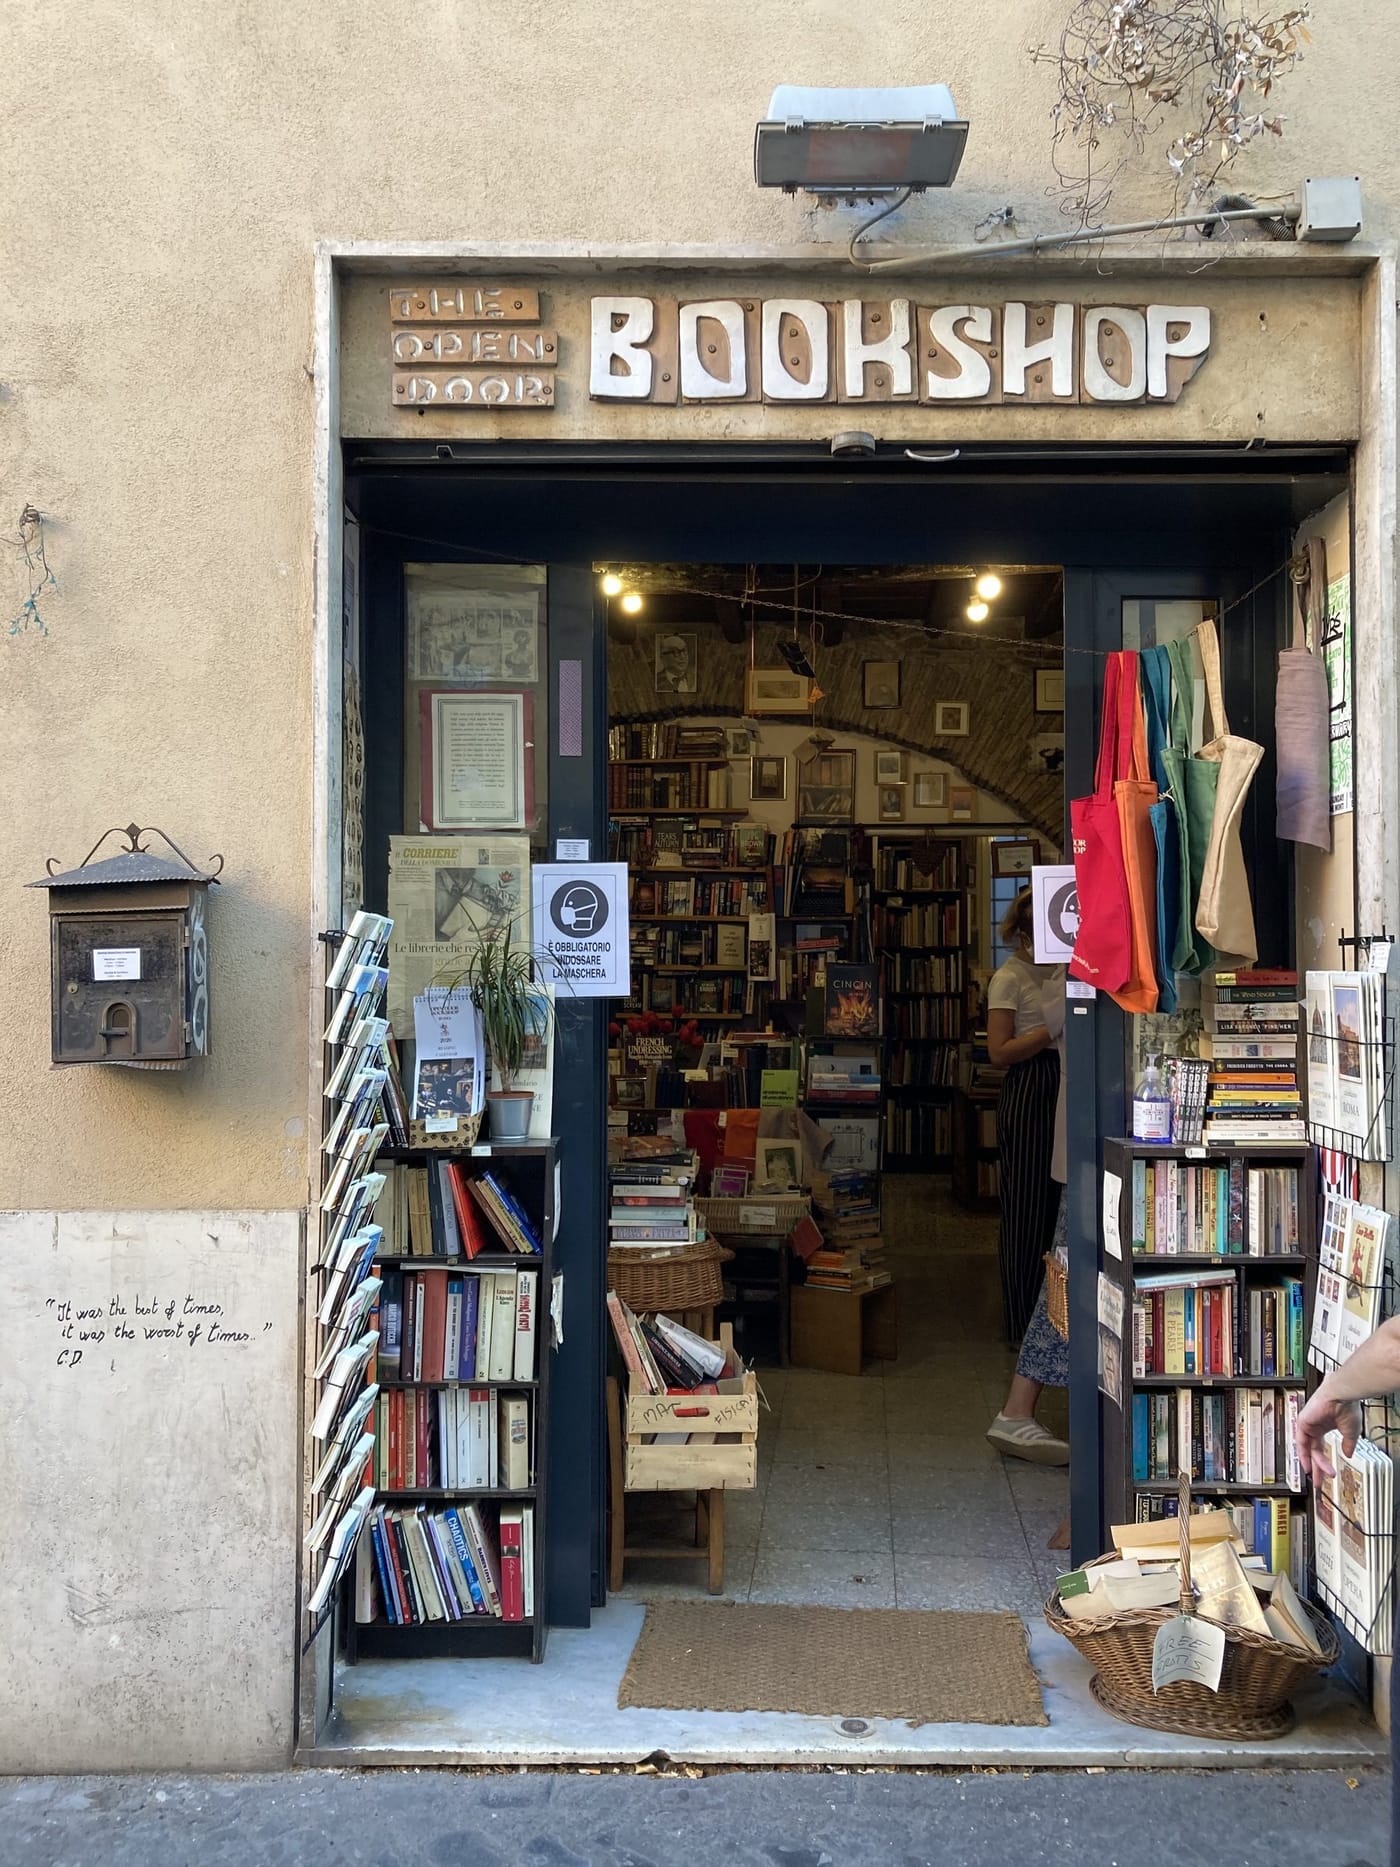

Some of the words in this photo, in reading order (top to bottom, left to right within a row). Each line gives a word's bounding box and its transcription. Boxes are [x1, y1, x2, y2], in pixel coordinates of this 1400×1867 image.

[391, 288, 504, 317] THE
[394, 331, 544, 360] OPEN
[590, 296, 1211, 401] BOOKSHOP
[409, 375, 546, 404] DOOR
[403, 848, 459, 858] CORRIERE
[395, 943, 406, 953] Le
[408, 942, 444, 953] librerie
[446, 942, 462, 953] che
[554, 942, 611, 952] OBBLIGATORIO
[557, 955, 601, 965] INDOSSARE
[552, 968, 562, 978] LA
[564, 968, 606, 978] MASCHERA
[832, 980, 872, 990] CINCIN
[628, 1046, 672, 1055] UNDRESSING
[636, 1037, 664, 1046] FRENCH
[1342, 1101, 1360, 1118] ROMA
[77, 1308, 103, 1320] was
[109, 1294, 127, 1316] the
[135, 1294, 159, 1316] best
[164, 1299, 176, 1318] of
[183, 1294, 224, 1319] times,
[386, 1304, 398, 1321] MARCO
[62, 1323, 73, 1338] it
[80, 1328, 106, 1343] was
[114, 1320, 136, 1339] the
[144, 1318, 185, 1340] worst
[188, 1328, 202, 1346] of
[386, 1322, 398, 1345] BUTICCHI
[1168, 1320, 1176, 1353] PEARSE
[1264, 1332, 1272, 1359] SABRE
[643, 1401, 681, 1424] MAT
[447, 1516, 469, 1562] CHAOTICS
[1344, 1576, 1364, 1603] OPERA
[1159, 1636, 1212, 1654] FREE
[1157, 1654, 1202, 1672] GRATIS
